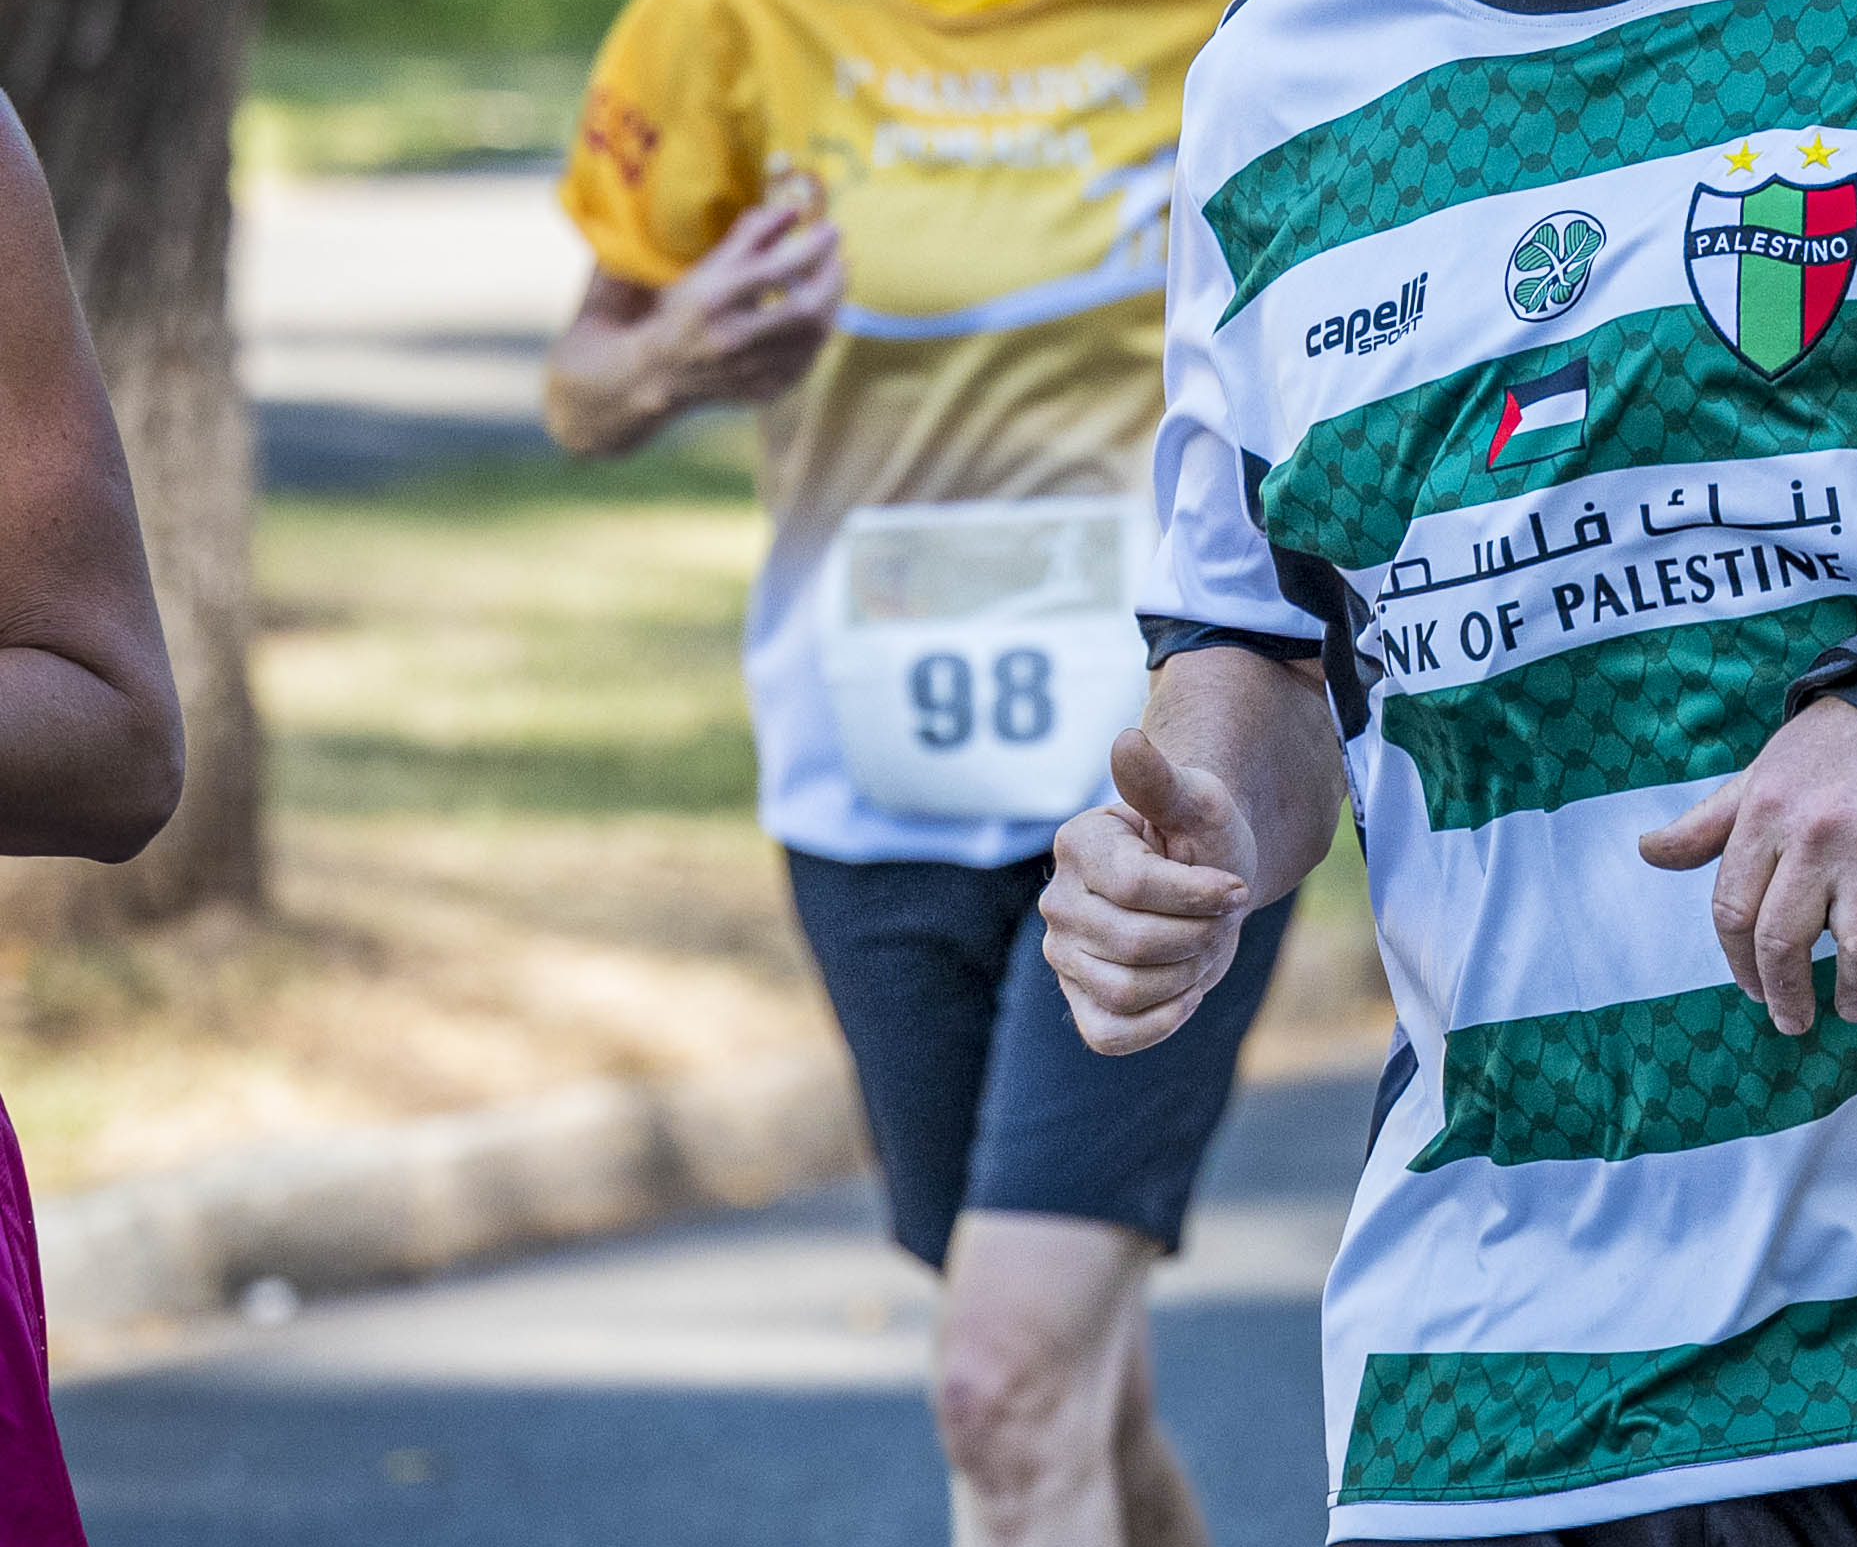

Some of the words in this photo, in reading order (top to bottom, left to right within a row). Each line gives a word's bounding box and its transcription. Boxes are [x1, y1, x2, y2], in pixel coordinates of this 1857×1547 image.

[1696, 231, 1848, 263] PALESTINO
[1305, 271, 1429, 358] capelli
[1358, 314, 1423, 356] SPORT
[1459, 599, 1524, 662] OF
[1551, 544, 1850, 632] PALESTINE
[908, 649, 1056, 752] 98
